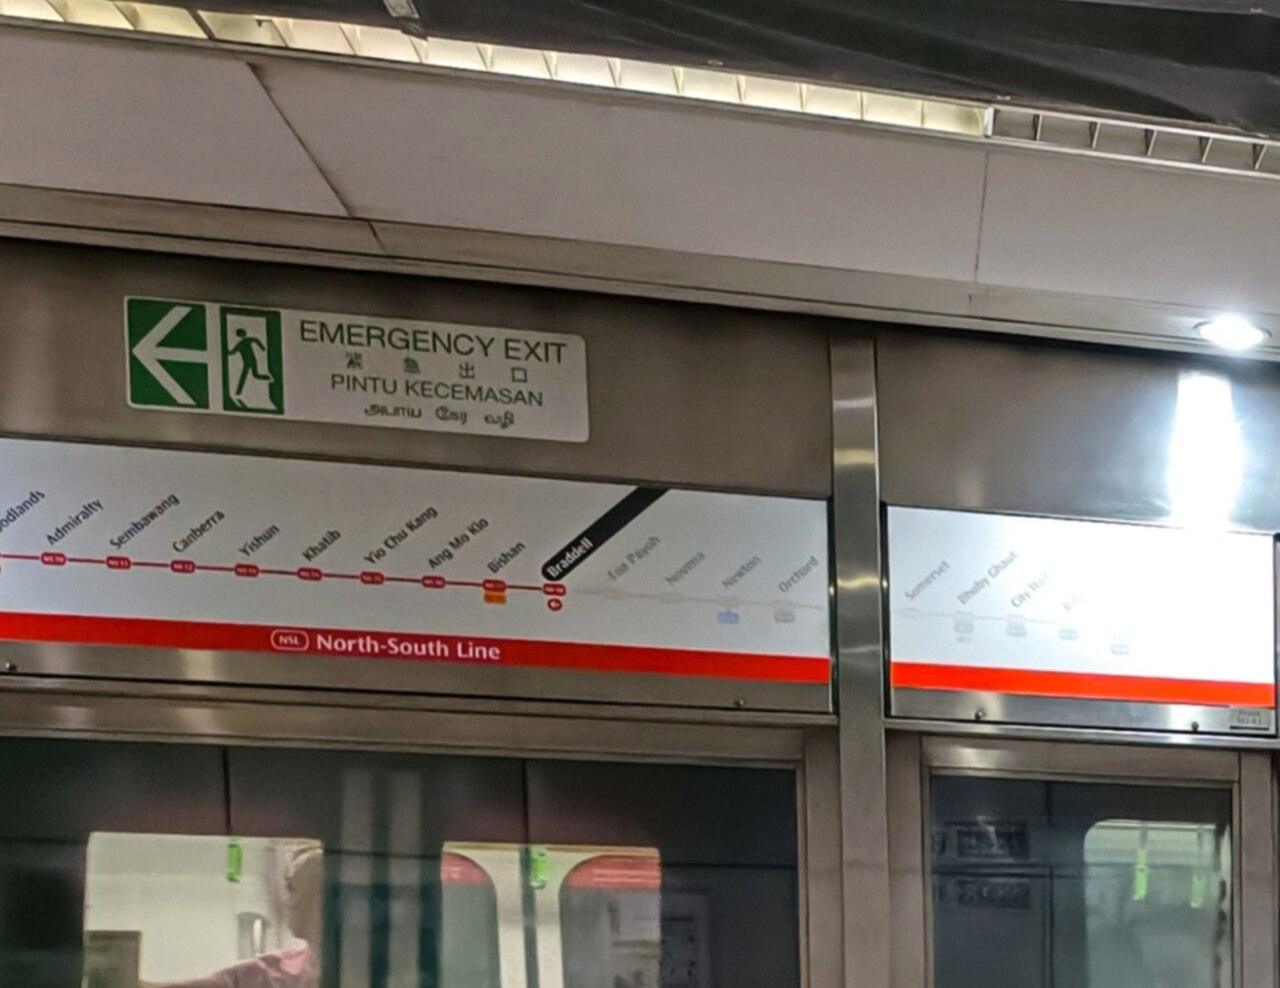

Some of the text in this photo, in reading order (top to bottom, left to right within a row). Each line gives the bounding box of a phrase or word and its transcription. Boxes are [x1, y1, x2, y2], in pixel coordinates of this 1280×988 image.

[300, 319, 566, 363] EMERGENCY EXIT
[331, 374, 543, 406] PINTU KECEMASAN
[0, 489, 45, 533] odlands
[46, 498, 104, 546] Admiralty
[110, 493, 180, 550] Sembawang
[172, 510, 225, 553] Canberra
[238, 523, 280, 557] Yishun
[302, 529, 341, 562] Khatib
[363, 506, 439, 566] Yio Chu Kang
[427, 517, 489, 570] Ang Mo Kio
[487, 541, 526, 574] Bishan
[547, 537, 594, 578] Braddell
[778, 556, 819, 593] Orchard
[904, 560, 951, 601] Somerset
[278, 635, 300, 646] NSL
[317, 634, 501, 660] North-South Line
